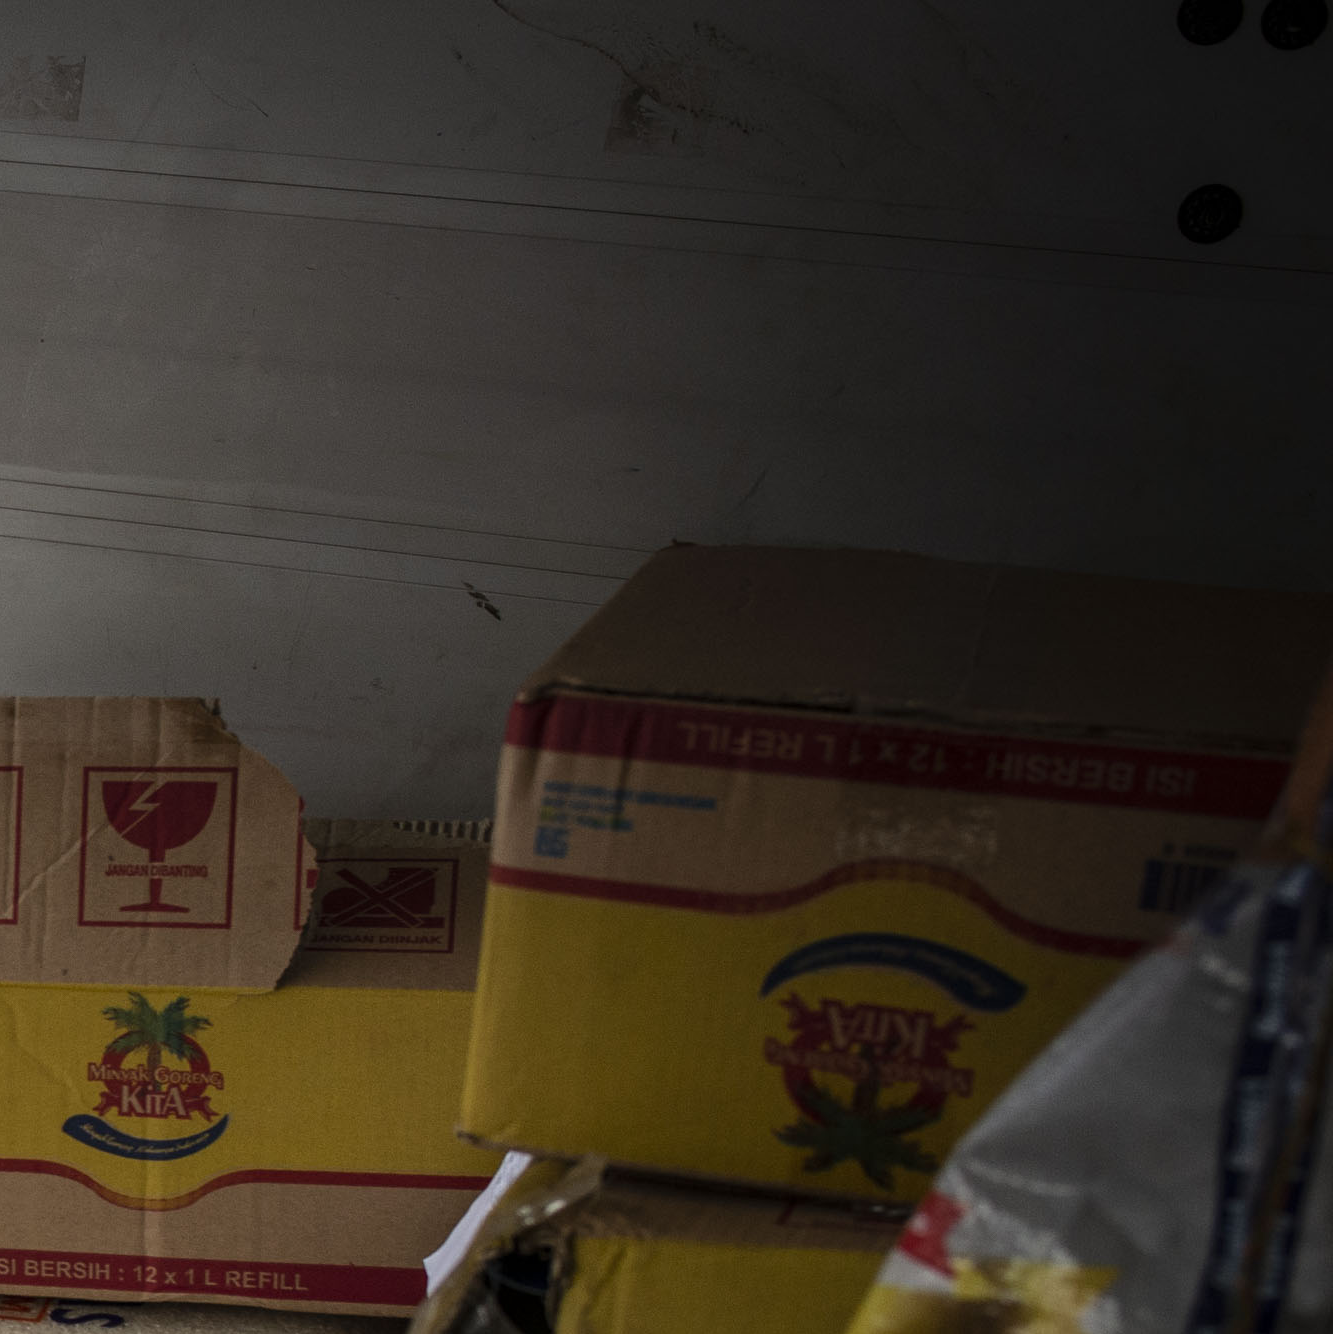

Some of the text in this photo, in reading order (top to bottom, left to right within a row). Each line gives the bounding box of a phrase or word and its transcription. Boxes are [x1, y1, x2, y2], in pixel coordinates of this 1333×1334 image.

[677, 719, 803, 758] REFILL
[985, 752, 1136, 794] BERSIH
[105, 863, 209, 878] JANGAN DIBANTING
[24, 1259, 111, 1281] BERSIH
[133, 1265, 159, 1284] 12
[164, 1271, 178, 1285] x
[186, 1268, 195, 1285] 1
[204, 1270, 219, 1286] L
[225, 1270, 310, 1292] REFILL
